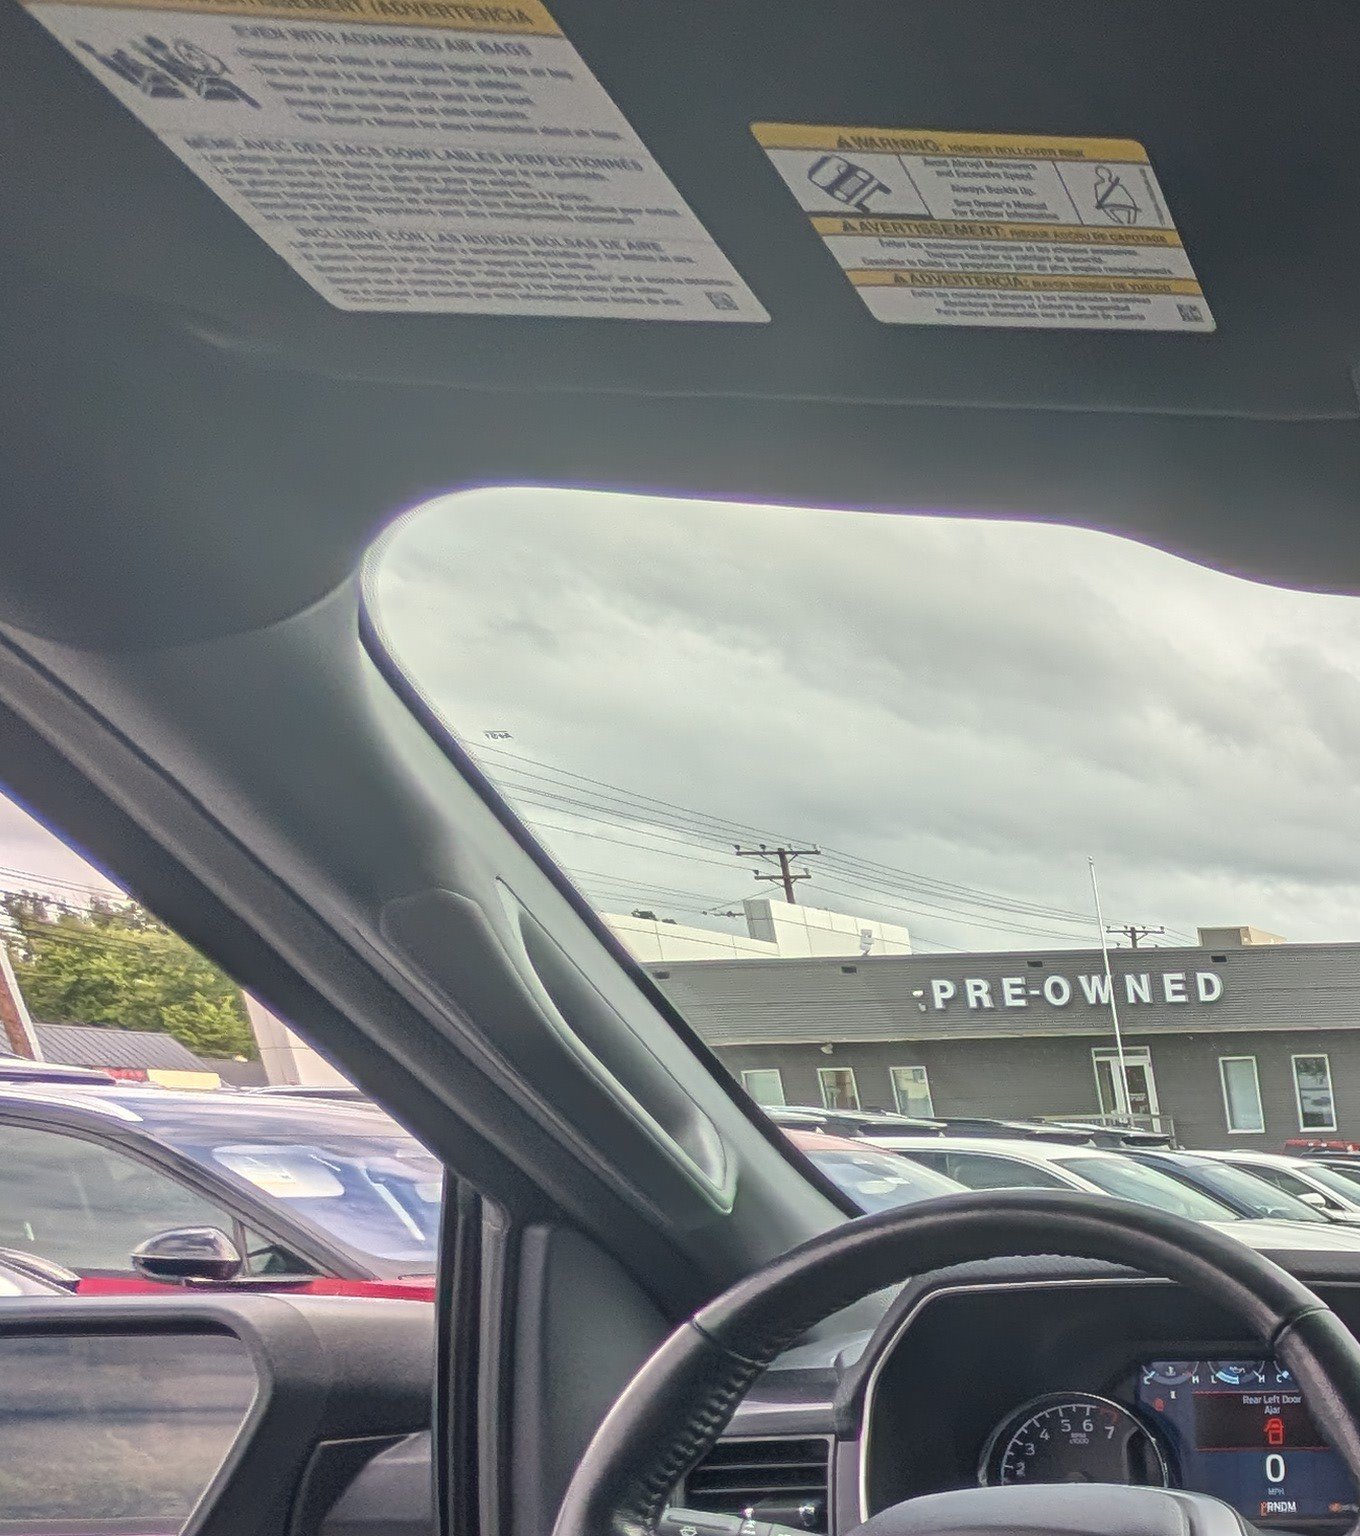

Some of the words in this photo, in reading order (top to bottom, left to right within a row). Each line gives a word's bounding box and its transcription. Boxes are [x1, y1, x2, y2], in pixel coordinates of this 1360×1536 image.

[931, 972, 1223, 1010] PRE-OWNED
[1242, 1395, 1262, 1404] Rear
[1263, 1395, 1281, 1404] Left
[1282, 1394, 1302, 1404] Door
[1264, 1405, 1281, 1415] Ajar
[1061, 1419, 1071, 1432] 5
[1082, 1419, 1094, 1432] 6
[1105, 1425, 1115, 1439] 7
[1039, 1428, 1050, 1440] 4
[1025, 1443, 1035, 1456] 3
[1265, 1453, 1286, 1483] 0
